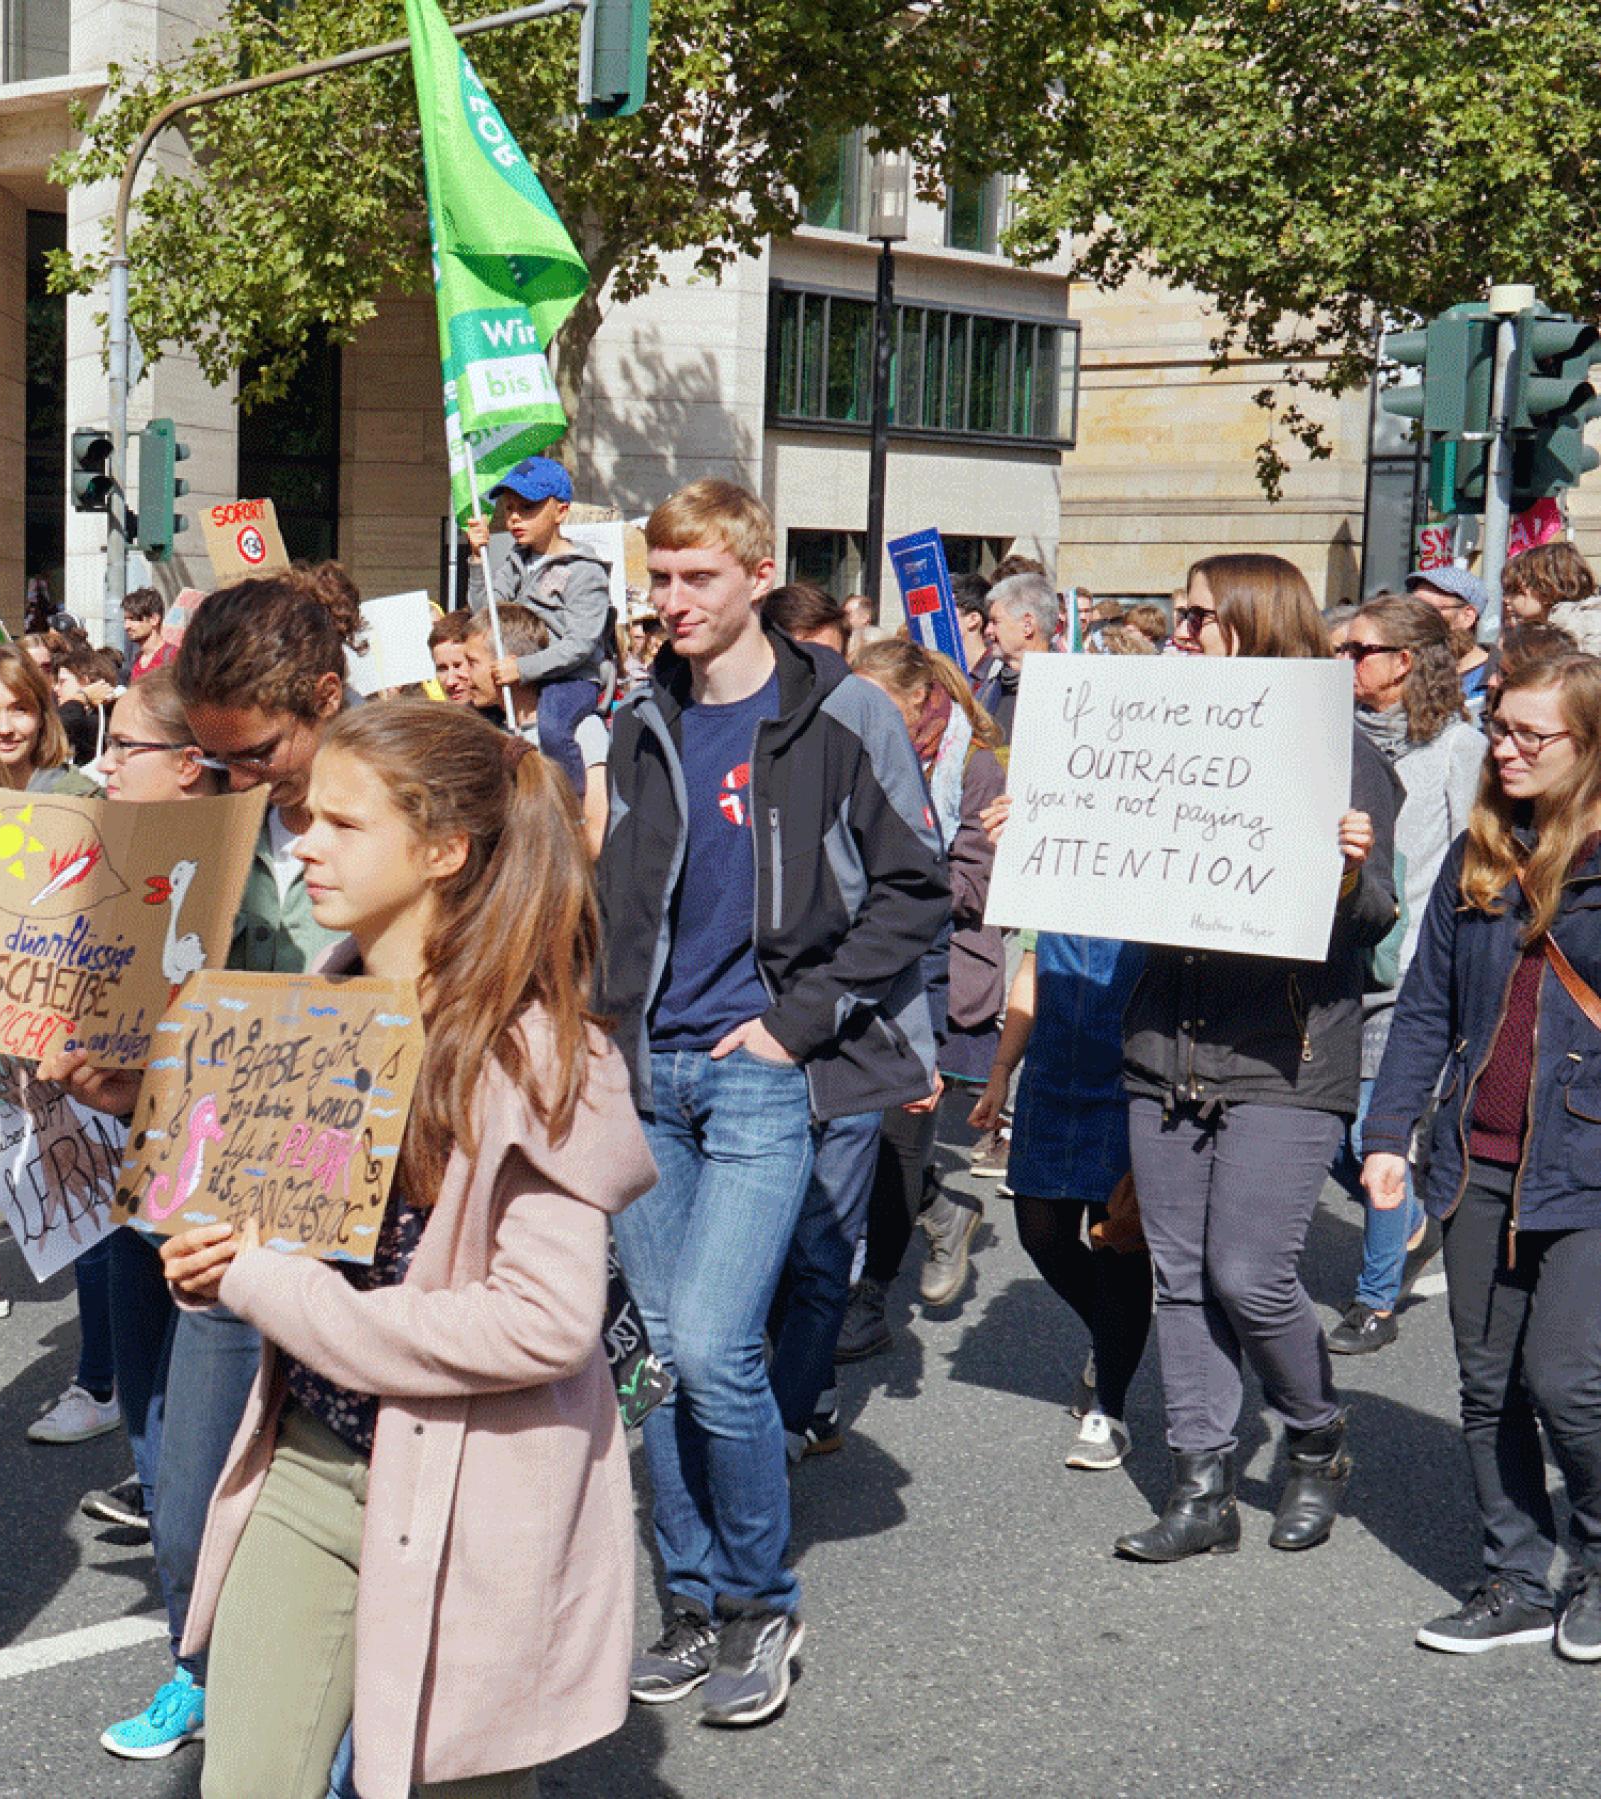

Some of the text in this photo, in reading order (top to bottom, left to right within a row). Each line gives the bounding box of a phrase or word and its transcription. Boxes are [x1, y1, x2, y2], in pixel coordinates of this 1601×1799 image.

[484, 368, 531, 398] bis
[1063, 680, 1096, 739] if
[1205, 686, 1271, 729] not
[1067, 744, 1252, 789] OUTRAGED
[1115, 786, 1161, 818] not
[1173, 803, 1273, 852] paying
[1020, 836, 1276, 895] ATTENTION
